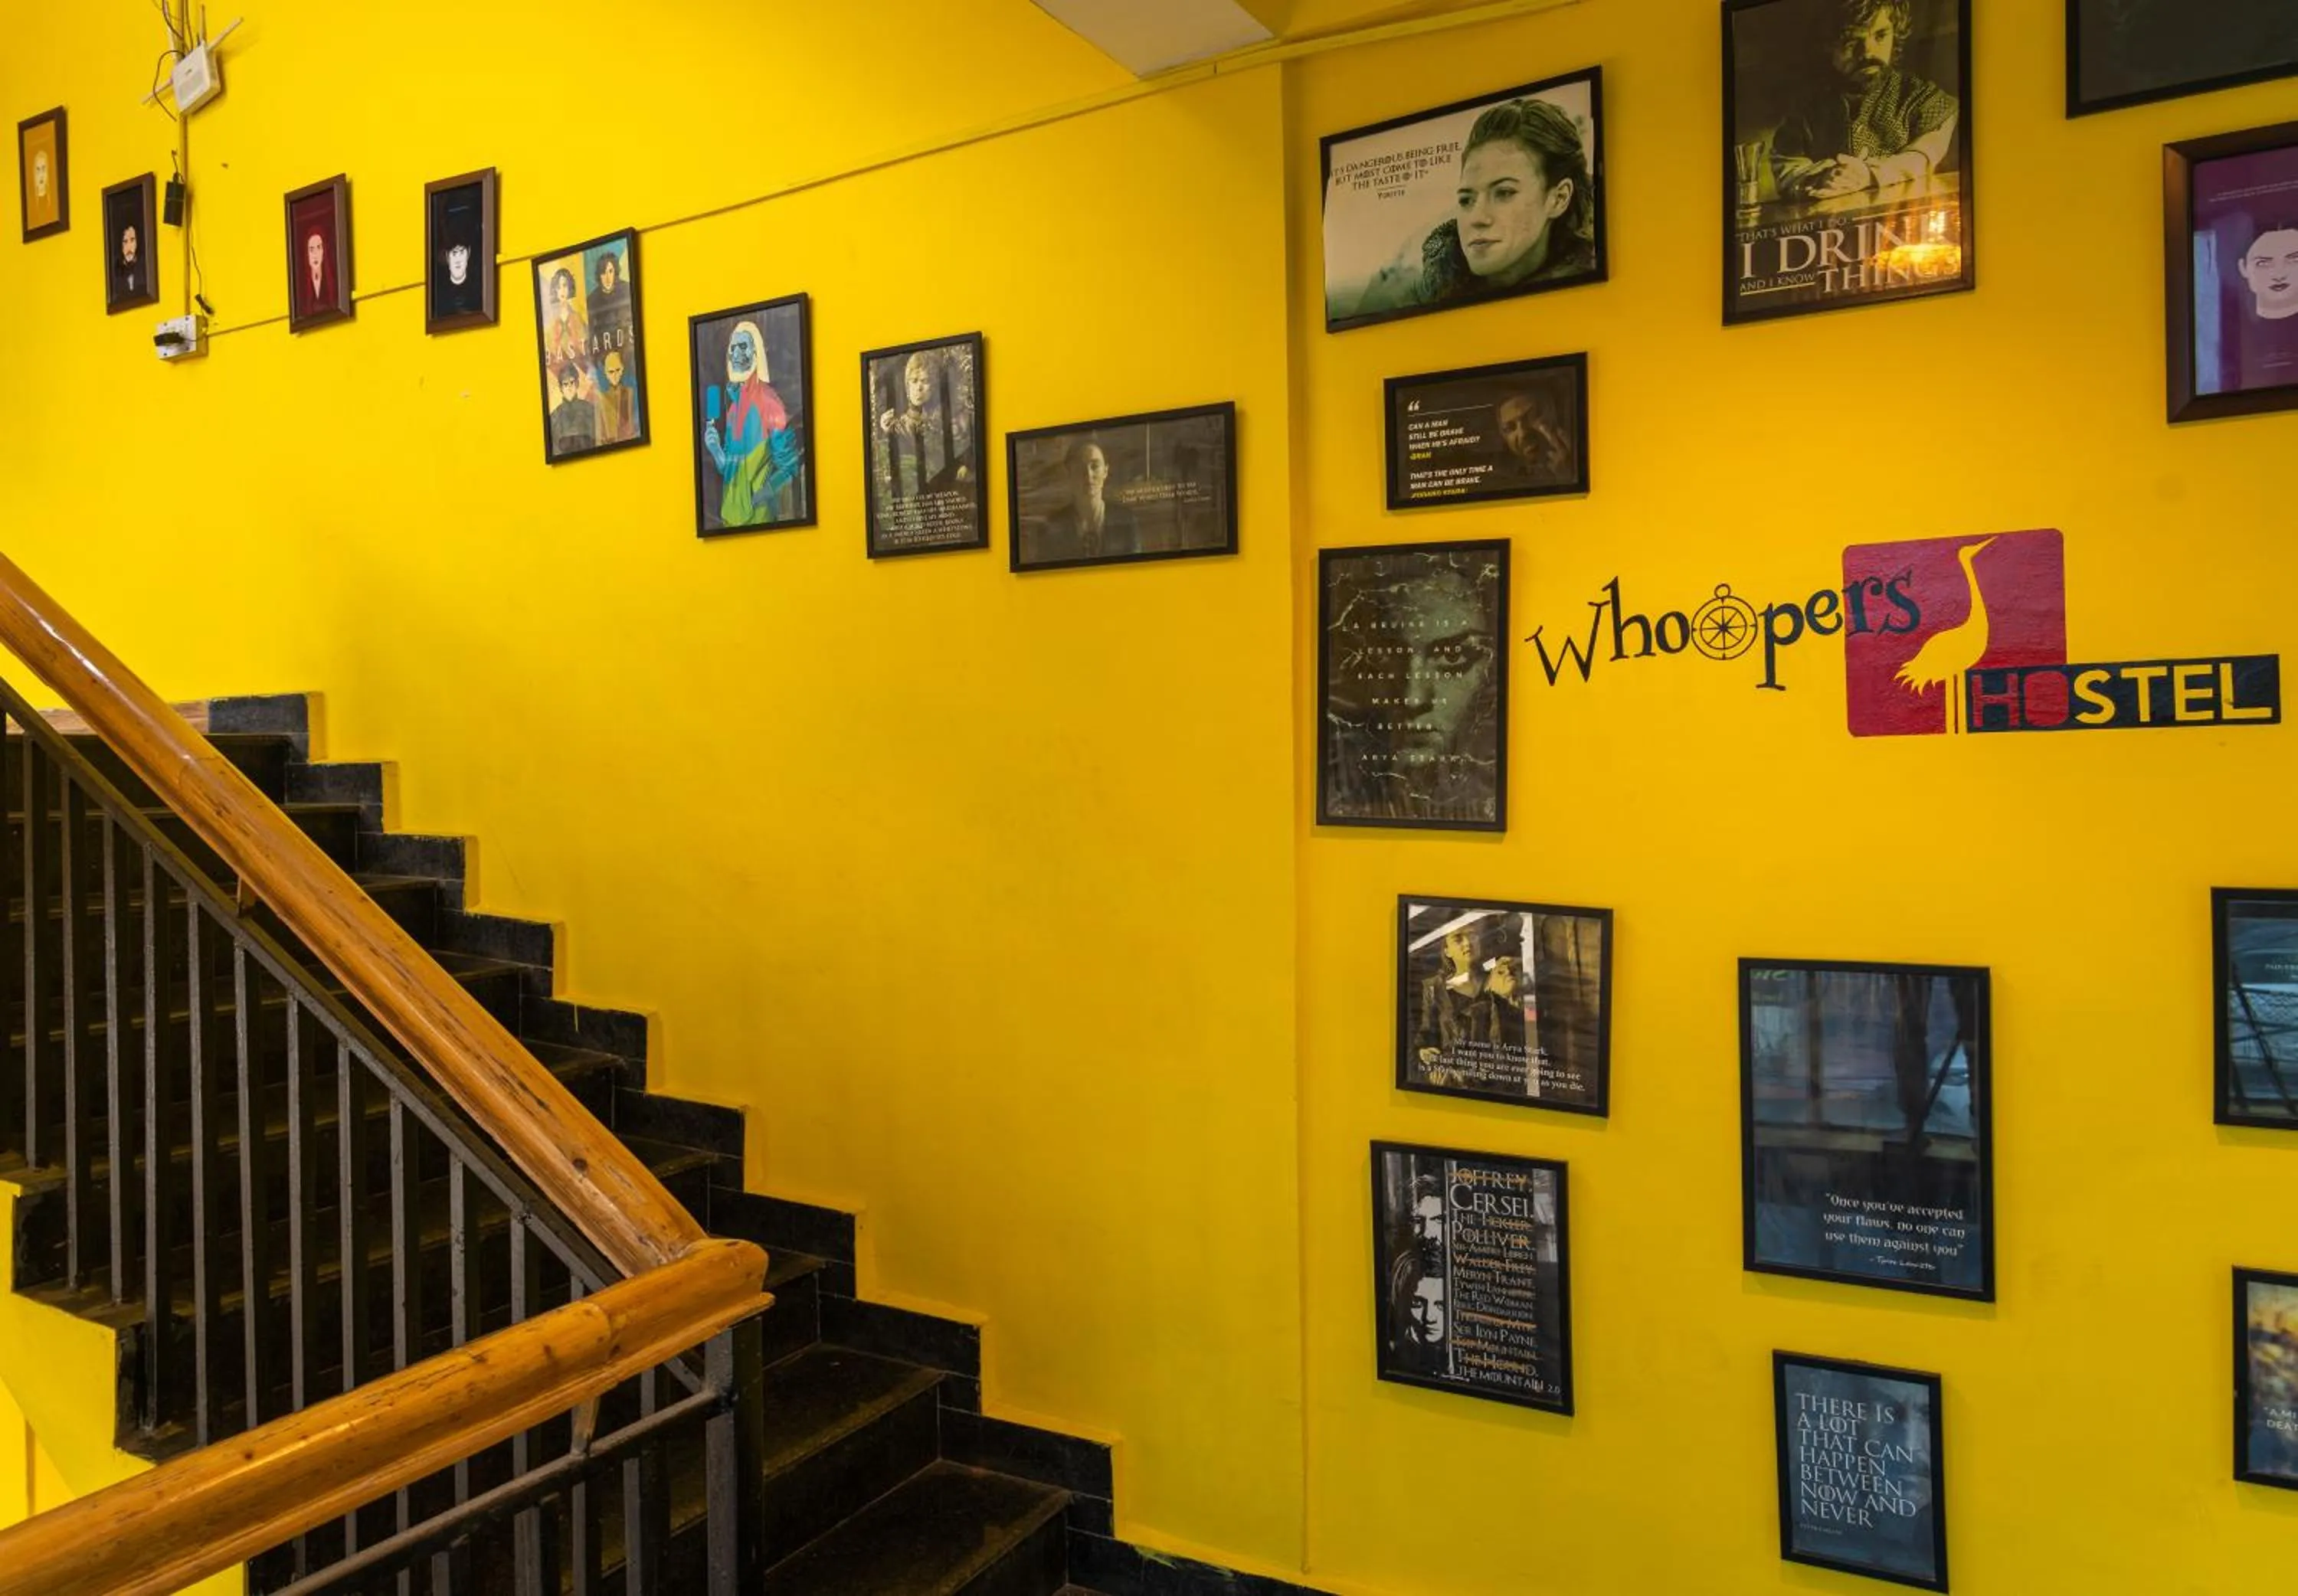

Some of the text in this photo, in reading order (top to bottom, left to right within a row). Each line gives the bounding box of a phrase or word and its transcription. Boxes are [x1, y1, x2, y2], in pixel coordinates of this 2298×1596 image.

[1406, 146, 1434, 160] BEING
[1354, 168, 1380, 180] MOST
[1414, 158, 1428, 168] TO
[1429, 154, 1452, 166] LIKE
[1354, 180, 1370, 191] THE
[1373, 173, 1400, 187] TASTE
[1736, 227, 1777, 244] THAT'S
[1779, 221, 1815, 235] WHAT
[1818, 219, 1824, 231] I
[1739, 212, 1958, 280] I DRINK
[1740, 261, 1959, 294] AND I KNOW THINGS
[545, 325, 635, 365] BASTARDS
[1435, 619, 1449, 627] IS
[1433, 645, 1462, 653] AND
[1405, 671, 1463, 679] LESSON
[1972, 662, 2273, 728] HOSTEL
[1457, 1048, 1477, 1058] want
[1439, 1055, 1454, 1065] last
[1455, 1056, 1478, 1068] thing
[1556, 1069, 1565, 1079] to
[1566, 1071, 1582, 1081] see
[1488, 1072, 1512, 1083] down
[1551, 1081, 1569, 1092] you
[1450, 1183, 1534, 1218] CERSEI.
[1862, 1200, 1904, 1213] you've
[1907, 1205, 1965, 1221] accepted
[1823, 1212, 1851, 1225] your
[1897, 1222, 1913, 1232] no
[1916, 1225, 1940, 1235] one
[1942, 1228, 1966, 1239] can
[1825, 1231, 1845, 1241] use
[1848, 1232, 1880, 1247] them
[1883, 1238, 1930, 1255] against
[1796, 1392, 1894, 1424] THERE IS
[1797, 1411, 1861, 1437] A LOT
[1799, 1428, 1914, 1464] THAT CAN
[1800, 1445, 1886, 1477] HAPPEN
[1801, 1464, 1902, 1497] BETWEEN
[1801, 1480, 1917, 1518] NOW AND
[1801, 1498, 1874, 1529] NEVER
